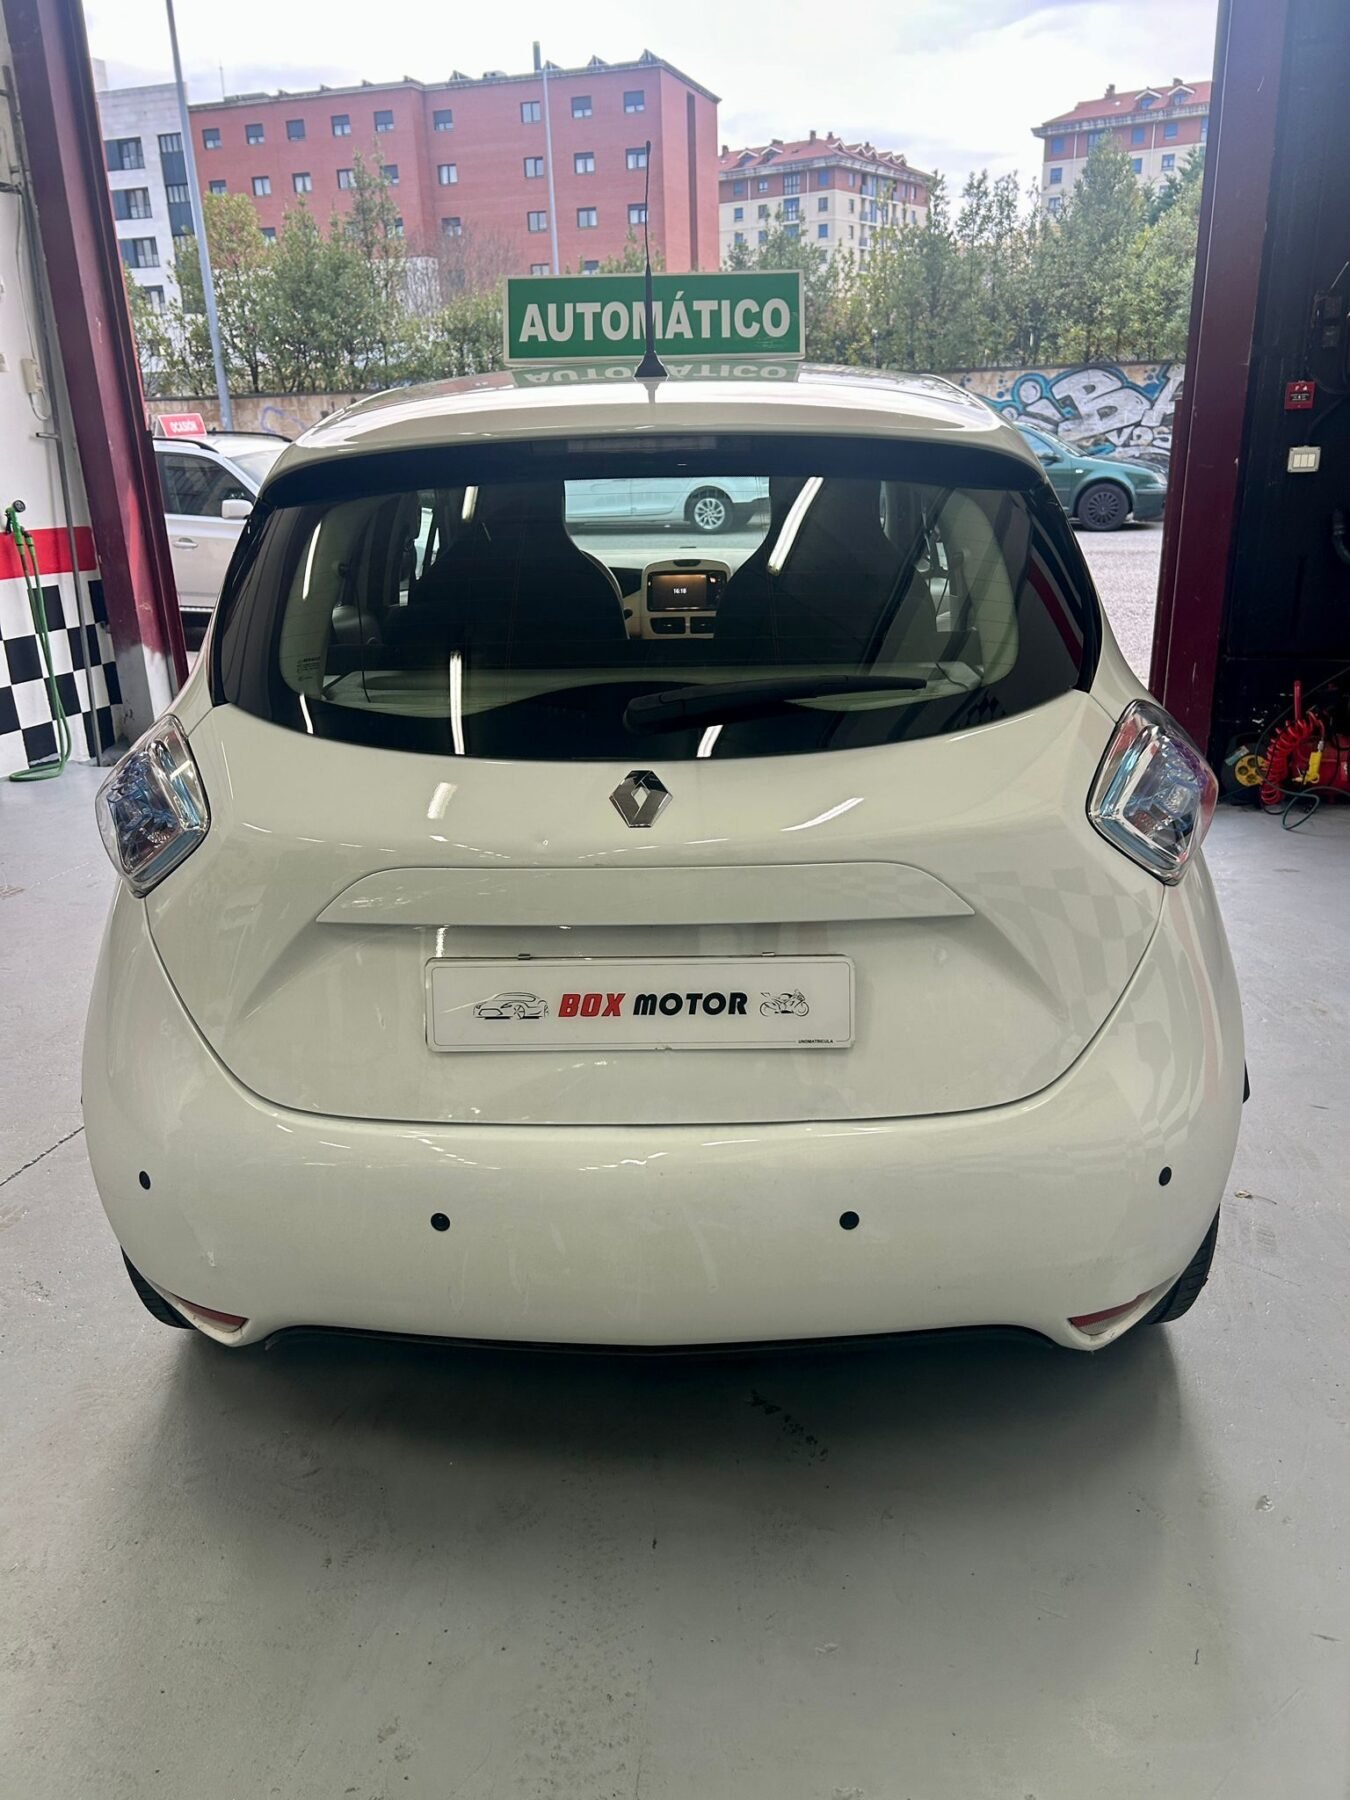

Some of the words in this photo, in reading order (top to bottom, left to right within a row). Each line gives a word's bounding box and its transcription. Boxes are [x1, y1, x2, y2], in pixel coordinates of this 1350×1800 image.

[519, 290, 791, 342] AUTOMÁTICO
[558, 993, 626, 1018] BOX
[633, 992, 748, 1016] MOTOR
